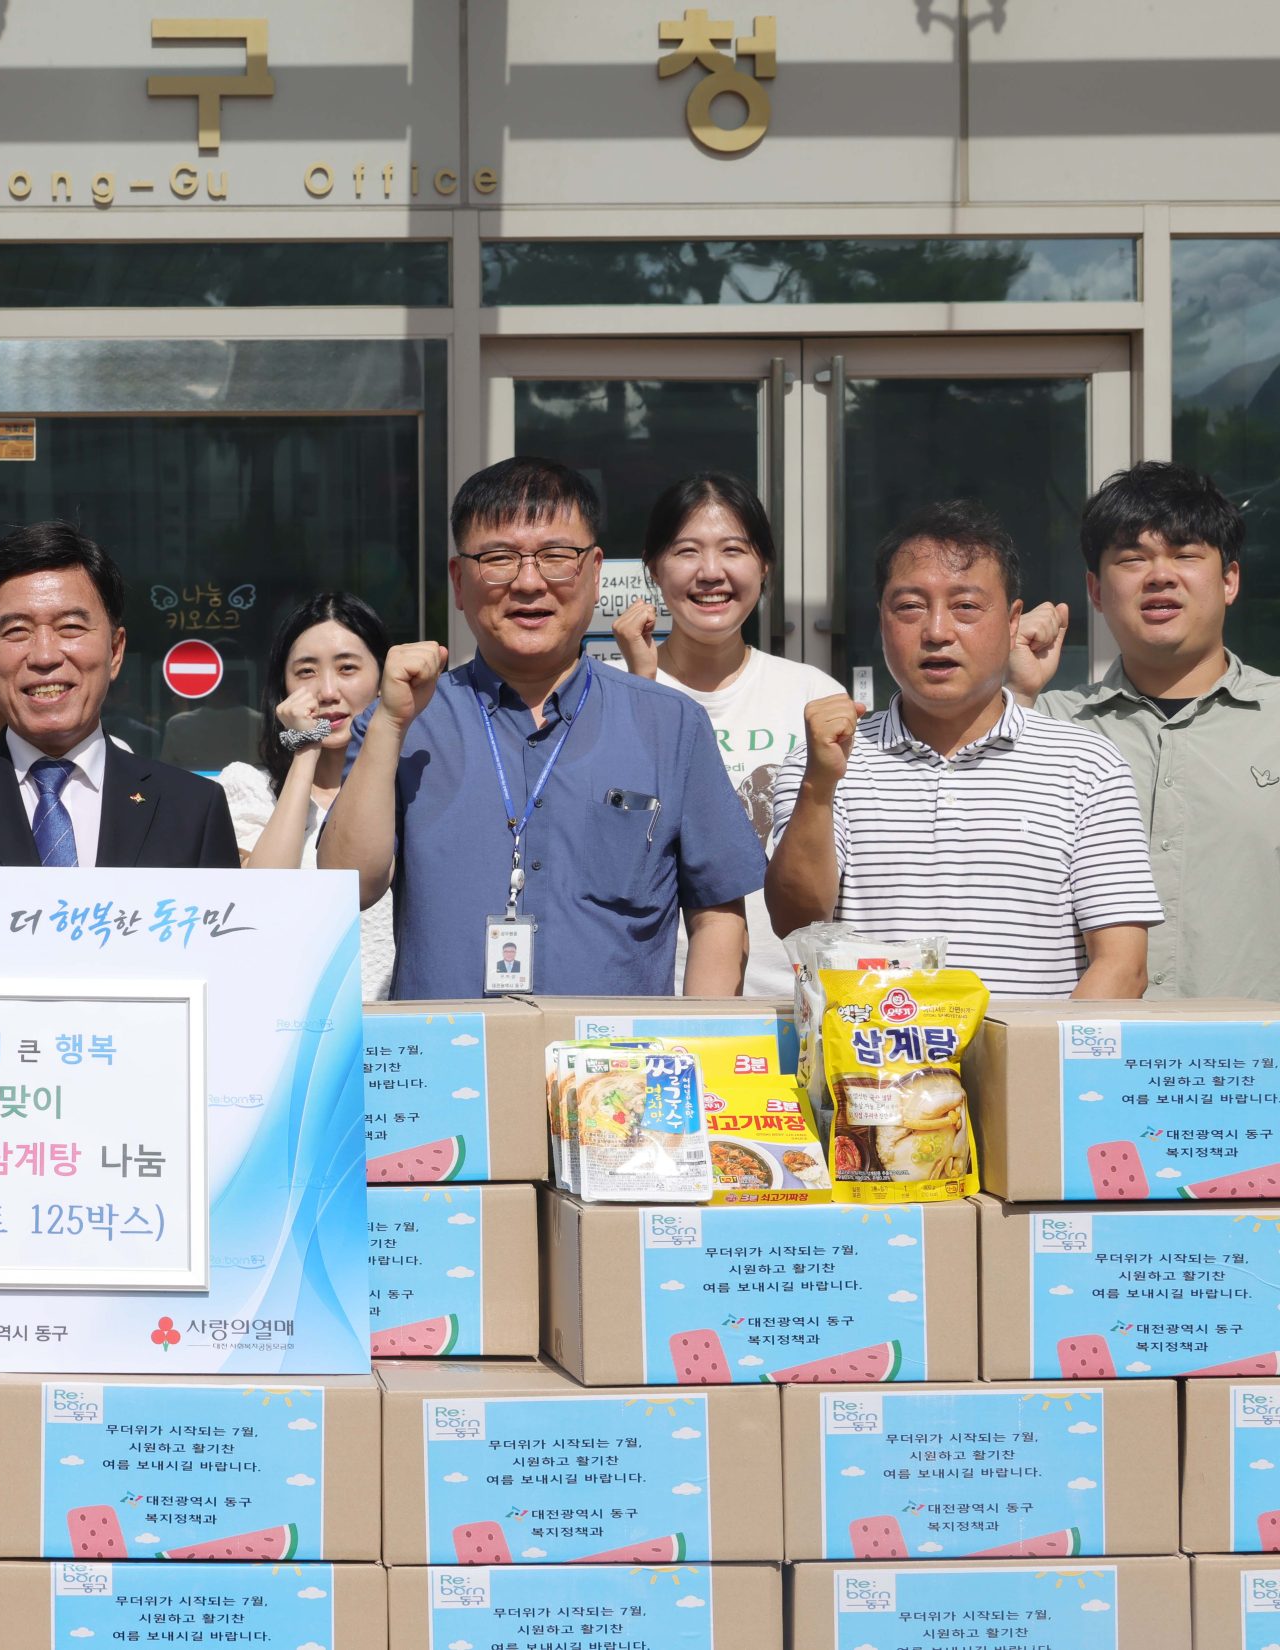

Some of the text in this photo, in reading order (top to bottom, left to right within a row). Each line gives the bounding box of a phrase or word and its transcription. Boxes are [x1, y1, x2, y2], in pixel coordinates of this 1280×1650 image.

[304, 163, 499, 199] Office
[602, 576, 641, 589] 24시간
[183, 582, 222, 607] 나눔
[165, 610, 240, 629] 키오스크
[10, 909, 43, 935] 더
[49, 899, 142, 949] 행복한
[148, 899, 259, 948] 동구민
[837, 1004, 873, 1023] 옛날
[886, 1007, 913, 1017] 오뚜기
[17, 1039, 41, 1063] 큰
[55, 1034, 117, 1066] 행복
[852, 1026, 960, 1066] 삼계탕
[735, 1055, 768, 1074] 3분
[1125, 1058, 1278, 1069] 무더위가 시작되는 7월,
[1148, 1076, 1255, 1086] 시원하고 활기찬
[645, 1084, 664, 1122] 멸치맛
[1122, 1095, 1149, 1104] 여름
[1156, 1094, 1212, 1104] 보내시길
[767, 1100, 799, 1112] 3분
[707, 1115, 806, 1131] 쇠고기짜장
[1167, 1130, 1273, 1139] 대전광역시 동구
[1166, 1148, 1238, 1157] 복지정책과
[101, 1143, 166, 1178] 나눔
[761, 1193, 808, 1201] 쇠고기짜장
[31, 1203, 165, 1241] 125박스)
[705, 1245, 858, 1257] 무더위가 시작되는 7월,
[729, 1263, 835, 1274] 시원하고 활기찬
[703, 1281, 862, 1293] 여름 보내시길 바랍니다.
[748, 1316, 854, 1327] 대전광역시 동구
[35, 1324, 68, 1342] 동구
[187, 1319, 294, 1341] 사랑의열매
[748, 1335, 820, 1345] 복지정책과
[886, 1432, 1037, 1444] 무더위가 시작되는 7월,
[910, 1450, 1015, 1461] 시원하고 활기찬
[884, 1467, 1041, 1479] 여름 보내시길 바랍니다.
[928, 1503, 1034, 1514] 대전광역시 동구
[928, 1521, 999, 1532] 복지정책과
